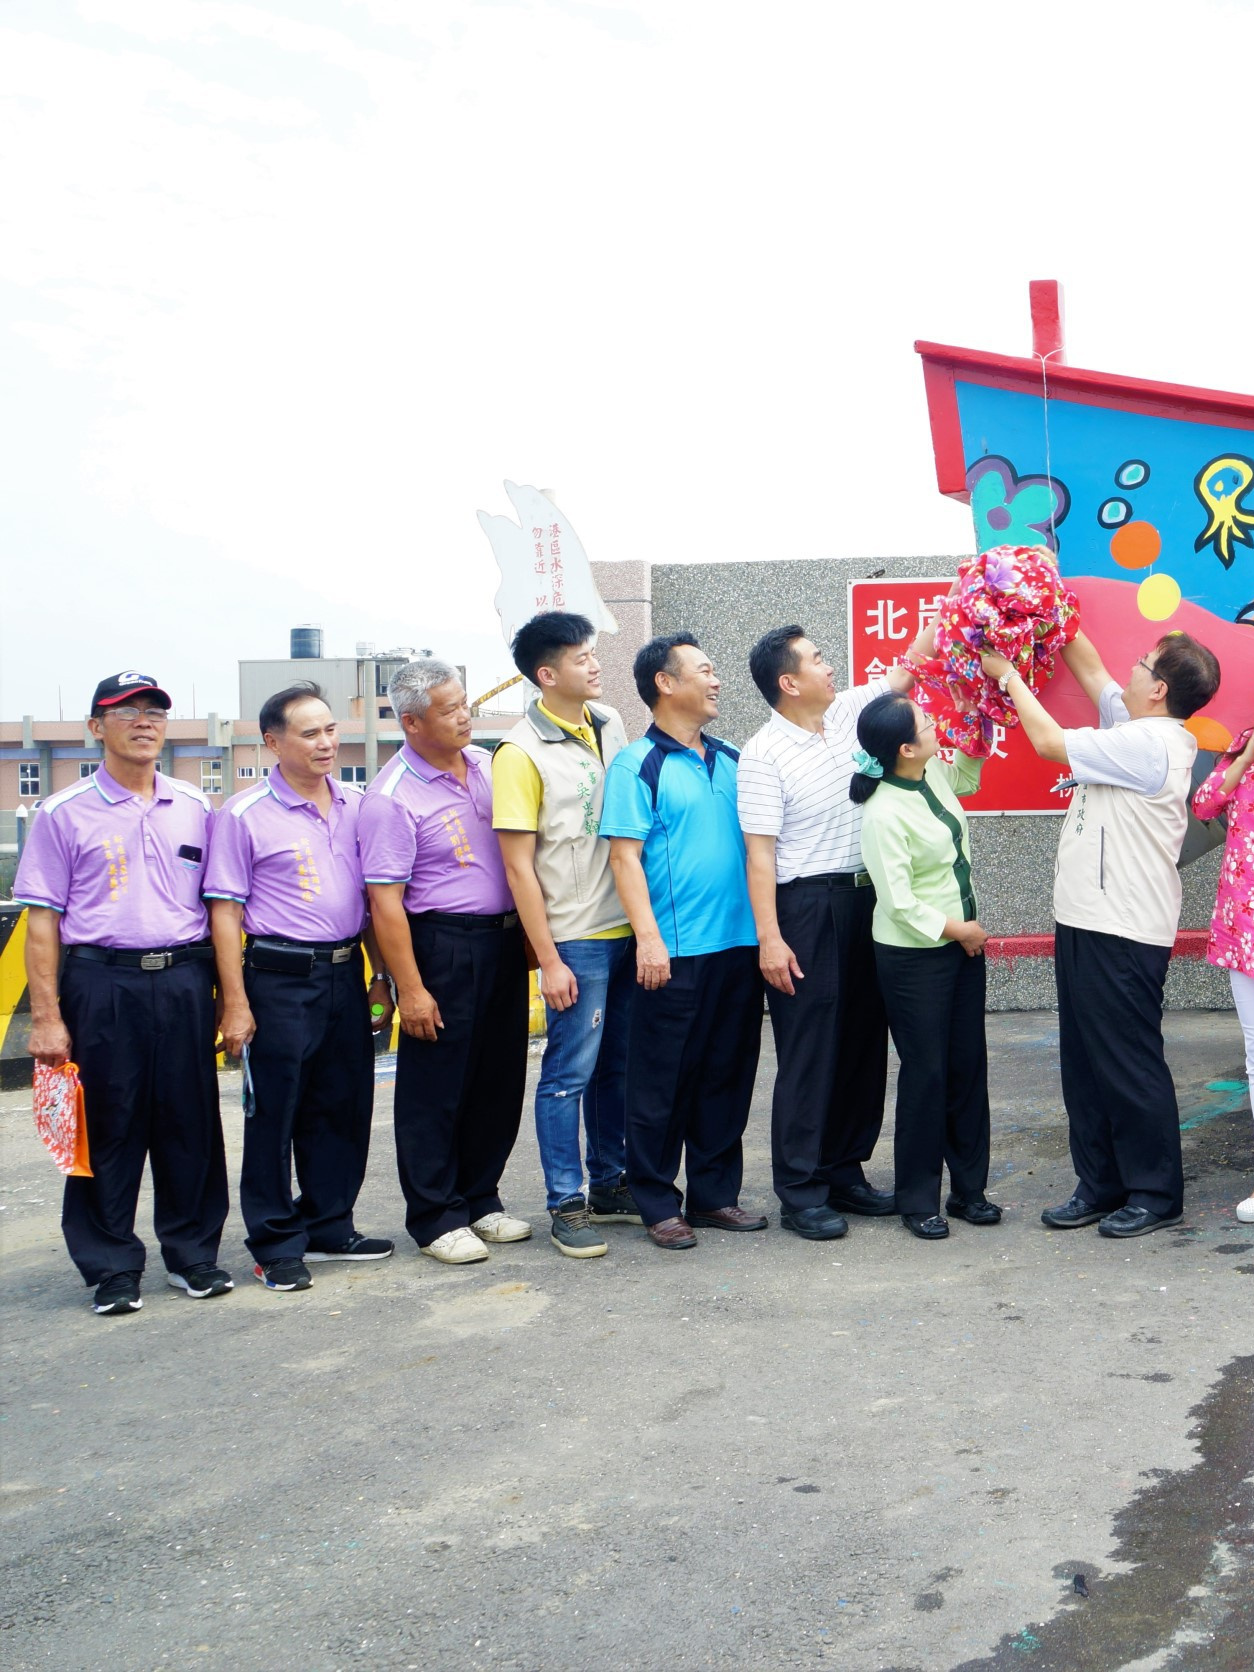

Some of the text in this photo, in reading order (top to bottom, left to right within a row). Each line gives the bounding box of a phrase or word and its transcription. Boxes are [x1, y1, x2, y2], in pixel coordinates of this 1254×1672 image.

[549, 523, 566, 616] 港區水深危
[1075, 784, 1088, 837] 市政府
